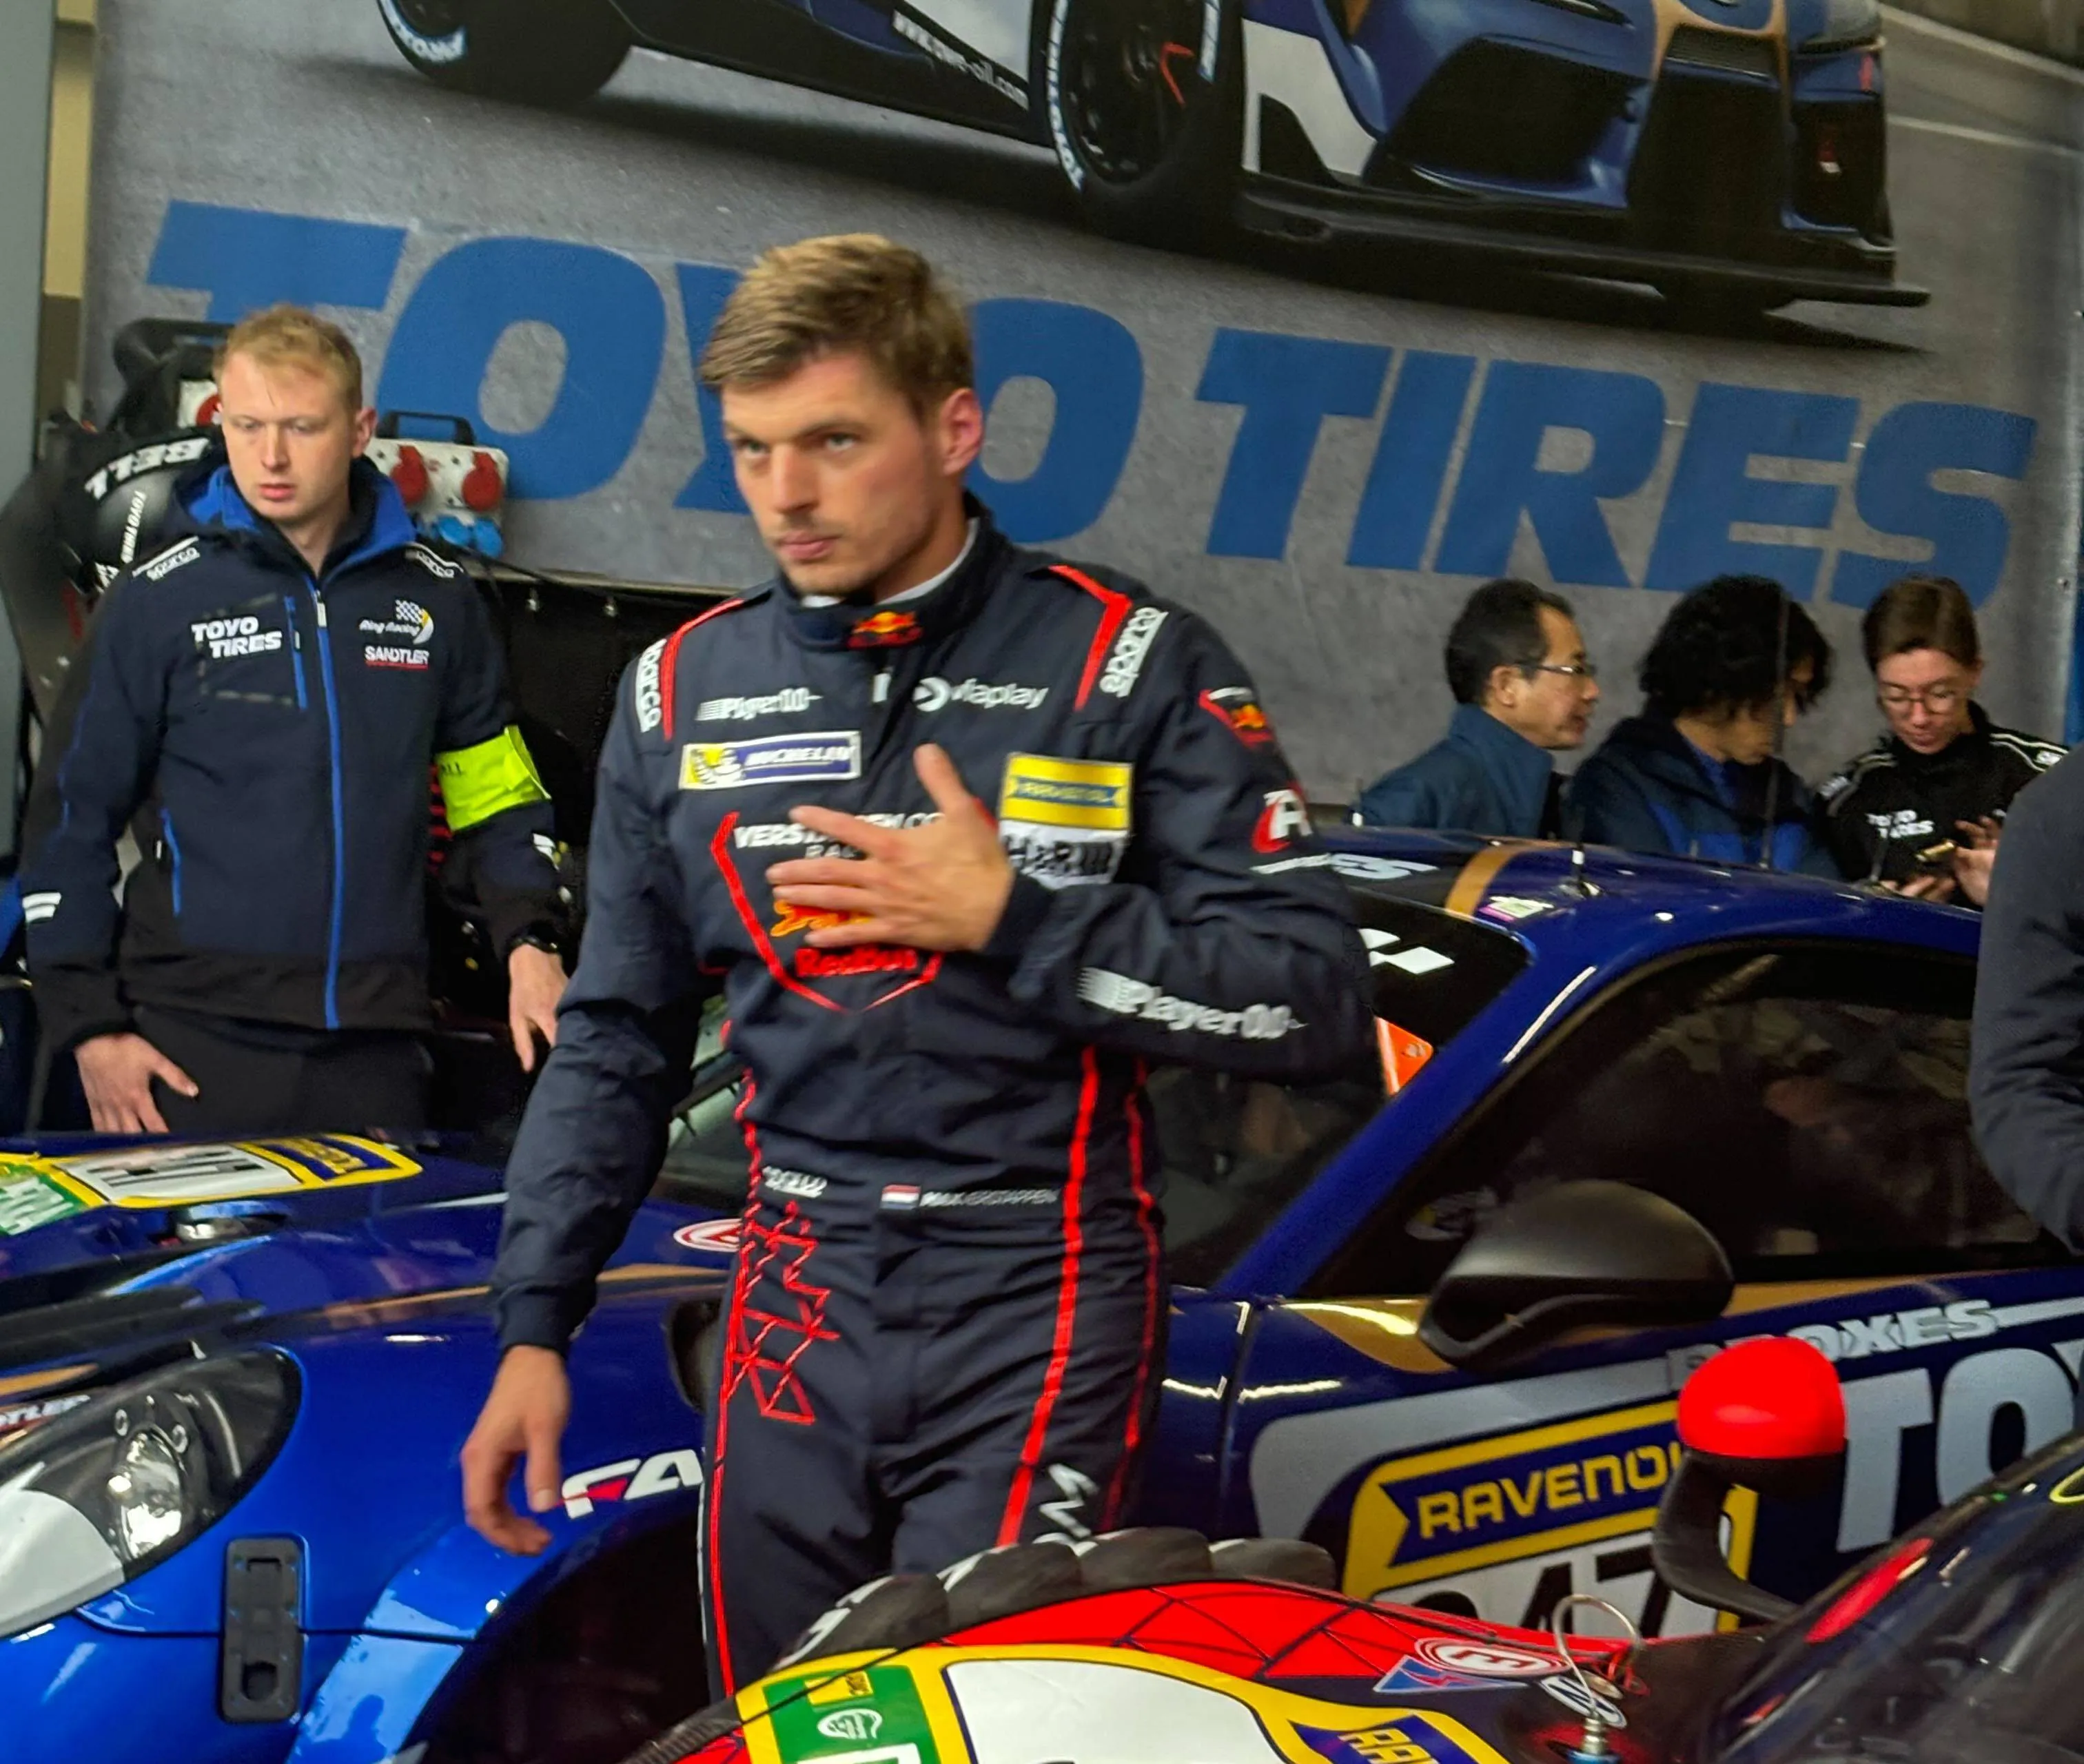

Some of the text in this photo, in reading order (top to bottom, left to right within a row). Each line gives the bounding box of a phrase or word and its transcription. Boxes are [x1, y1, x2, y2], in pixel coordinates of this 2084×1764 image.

[147, 200, 2038, 612] TOO TIRES
[191, 615, 259, 642] TOYO
[209, 630, 283, 659] TIRES
[1099, 606, 1169, 698] sparco
